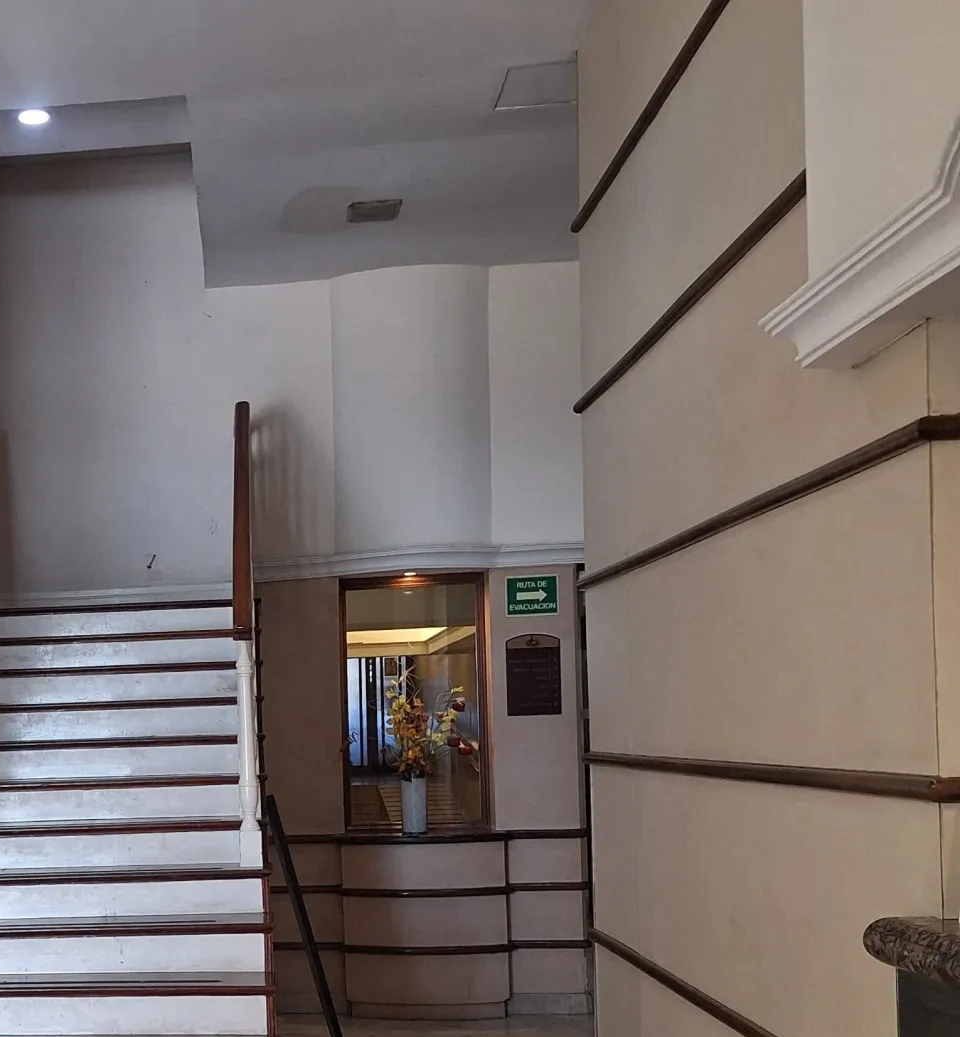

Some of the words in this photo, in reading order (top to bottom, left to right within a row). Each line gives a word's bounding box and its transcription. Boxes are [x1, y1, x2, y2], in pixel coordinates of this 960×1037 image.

[516, 581, 536, 589] RUTA
[537, 580, 547, 588] DE
[509, 602, 556, 611] EVACUACION
